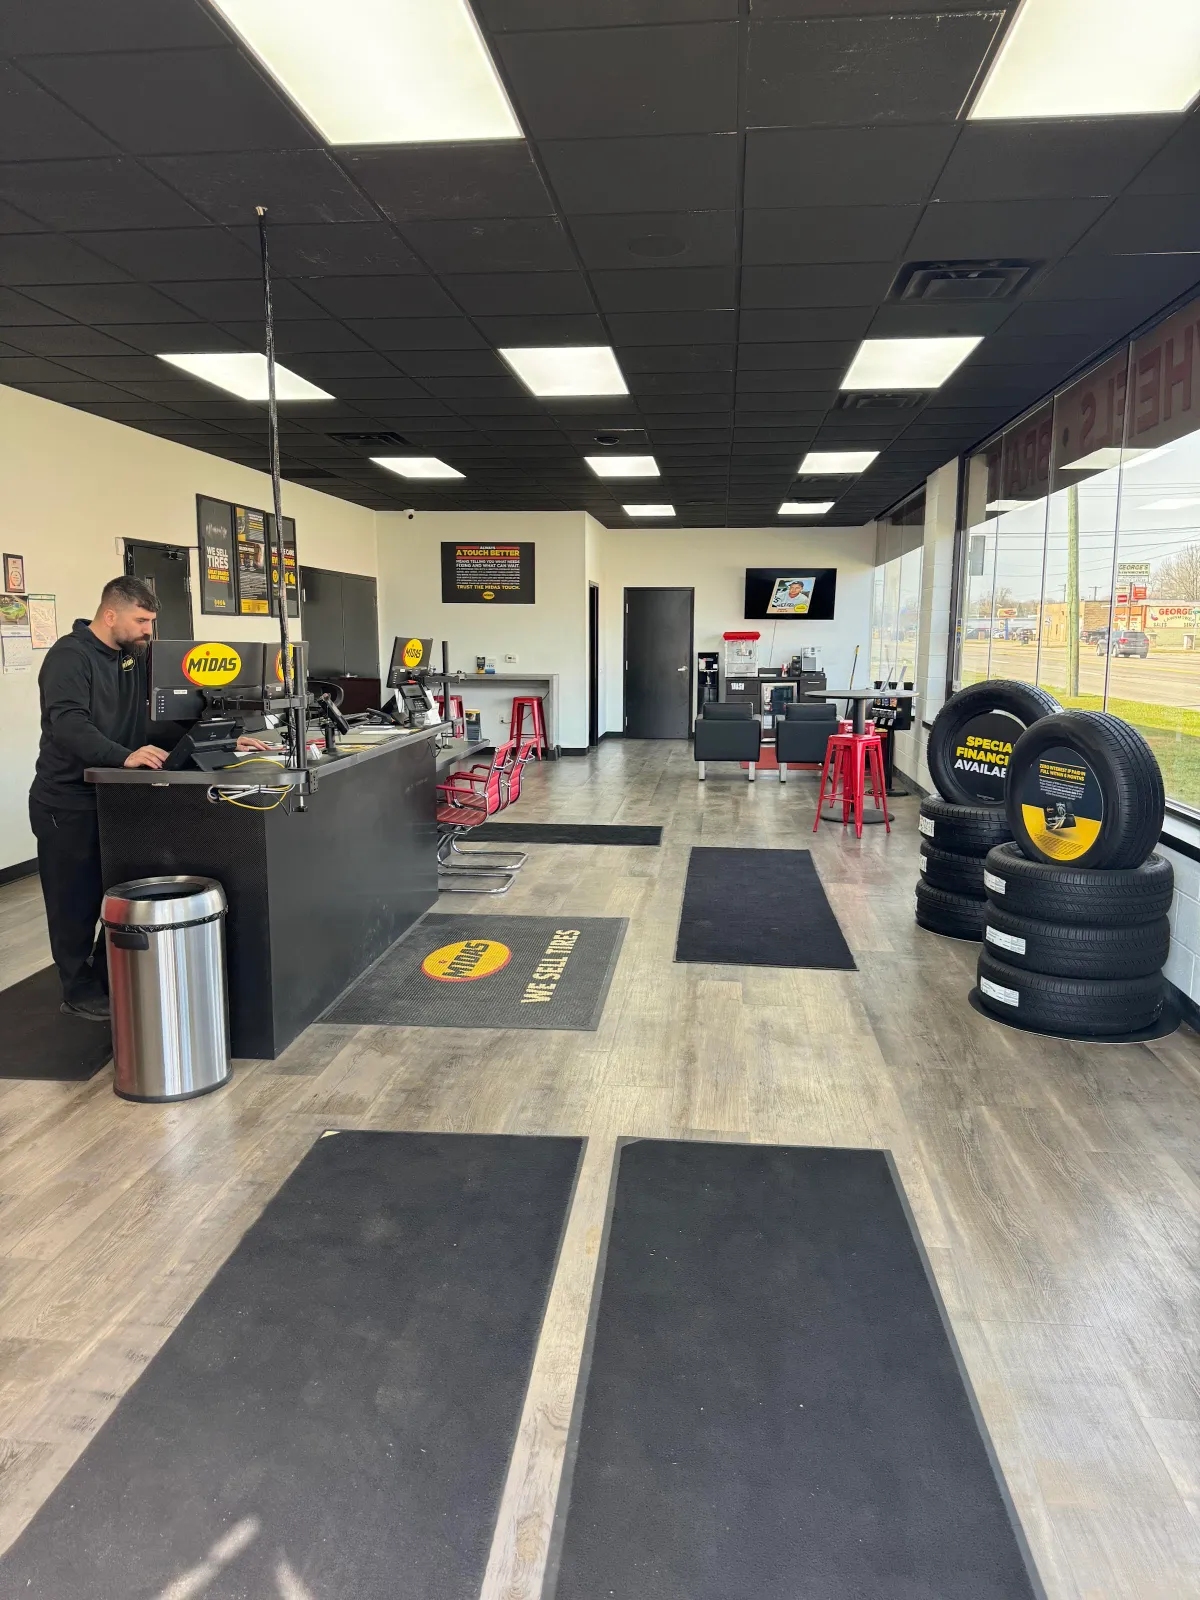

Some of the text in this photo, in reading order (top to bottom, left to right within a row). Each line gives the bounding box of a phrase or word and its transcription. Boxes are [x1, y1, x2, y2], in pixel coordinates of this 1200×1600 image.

[207, 546, 228, 557] WE SELL
[207, 555, 229, 569] TIRES
[406, 648, 421, 658] MIDAS
[187, 657, 237, 674] MIDAS
[966, 735, 1015, 754] SPECIA
[956, 746, 1009, 766] FINANCI
[954, 759, 1007, 779] AVAILAB
[442, 941, 490, 978] MIDAS
[520, 929, 581, 1003] WE SELL TIRES
